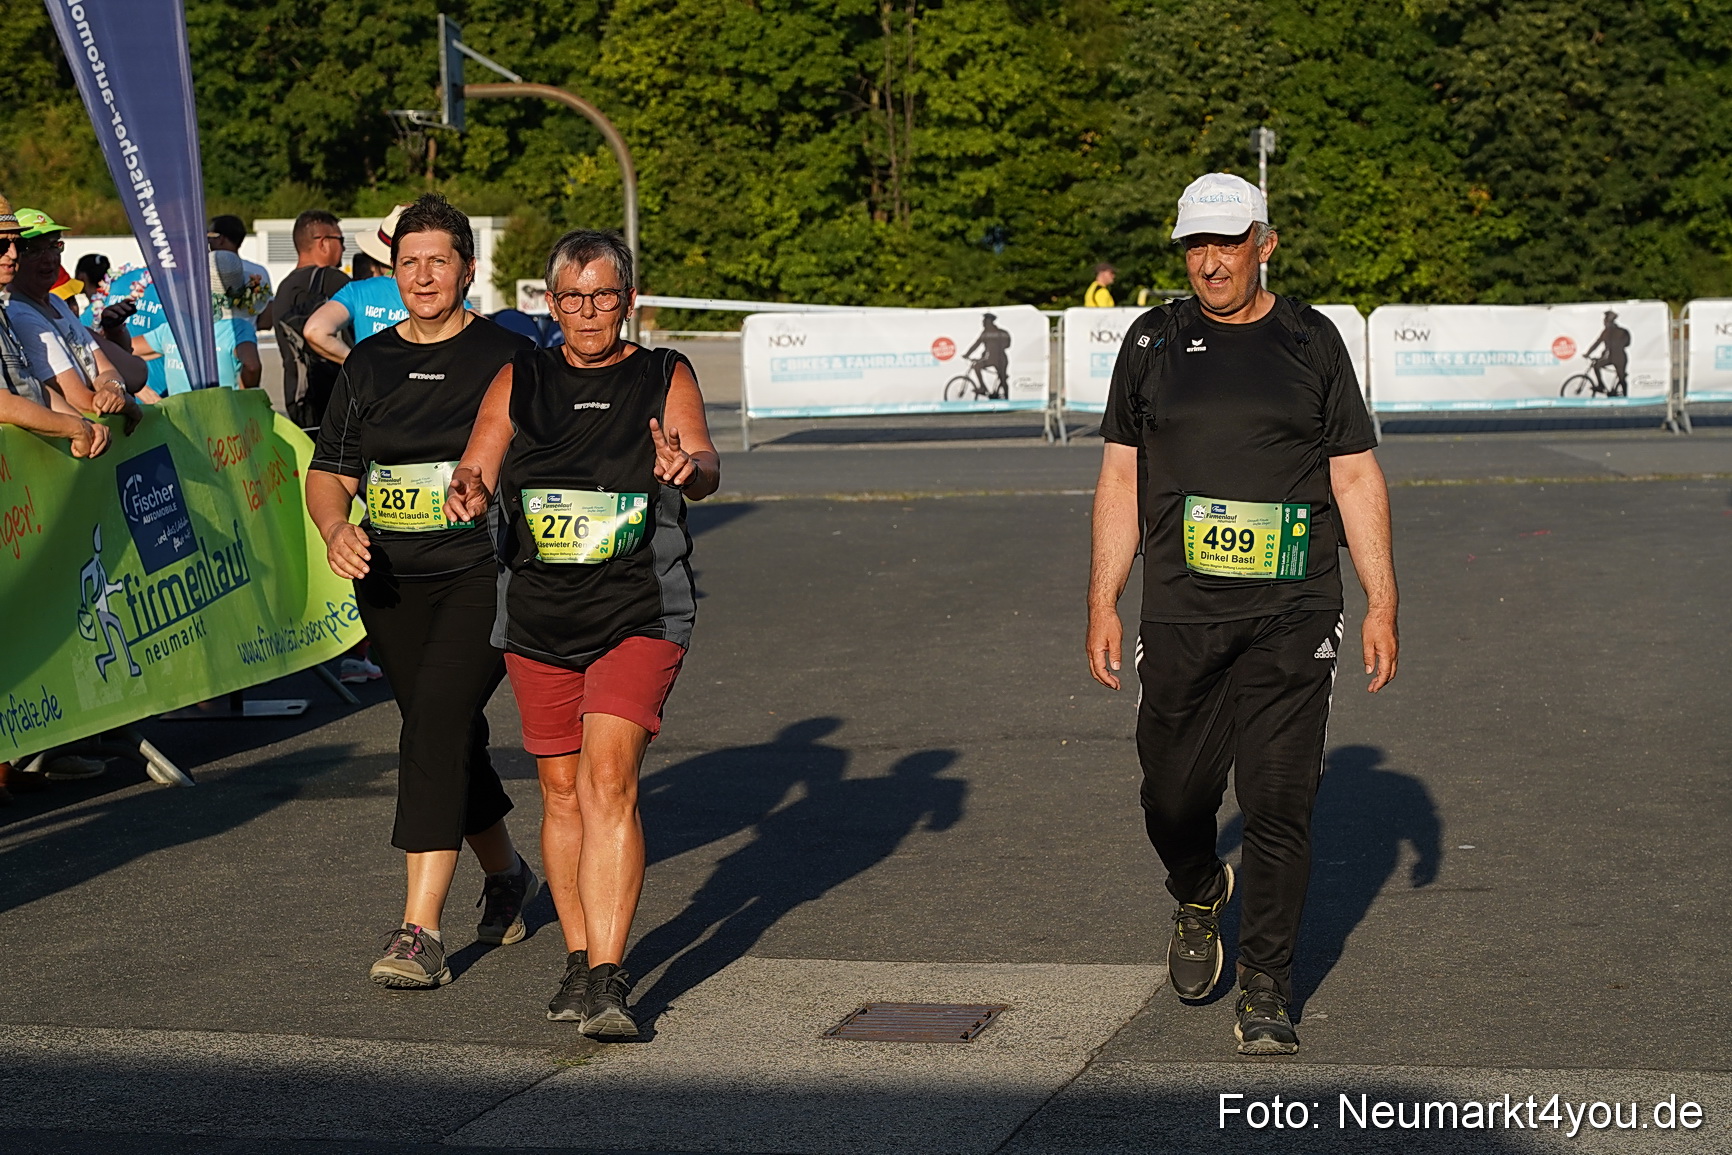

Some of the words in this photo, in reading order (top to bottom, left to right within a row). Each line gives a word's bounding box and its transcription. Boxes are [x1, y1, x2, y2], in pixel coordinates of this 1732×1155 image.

[365, 304, 386, 319] Hier
[768, 334, 807, 347] NOW
[1394, 328, 1431, 342] NOW
[771, 356, 830, 372] E-BIKES
[831, 355, 843, 370] &
[1397, 352, 1451, 366] E-BIKES
[1453, 352, 1466, 365] &
[132, 484, 174, 515] Fischer
[369, 488, 378, 520] WALK
[379, 487, 420, 510] 287
[431, 490, 442, 521] 2022
[542, 502, 573, 510] Firmenlauf
[142, 502, 178, 525] AUTOMOBILE
[378, 510, 398, 519] Mendl
[398, 511, 430, 520] Claudia
[1205, 513, 1238, 521] Firmenlauf
[541, 515, 590, 540] 276
[1203, 526, 1255, 553] 499
[1200, 551, 1229, 563] Dinkel
[1231, 554, 1256, 564] Basti
[1264, 534, 1275, 567] 2022
[123, 519, 251, 641] firmenlauf
[144, 615, 207, 666] neumarkt
[1314, 651, 1336, 659] adidas
